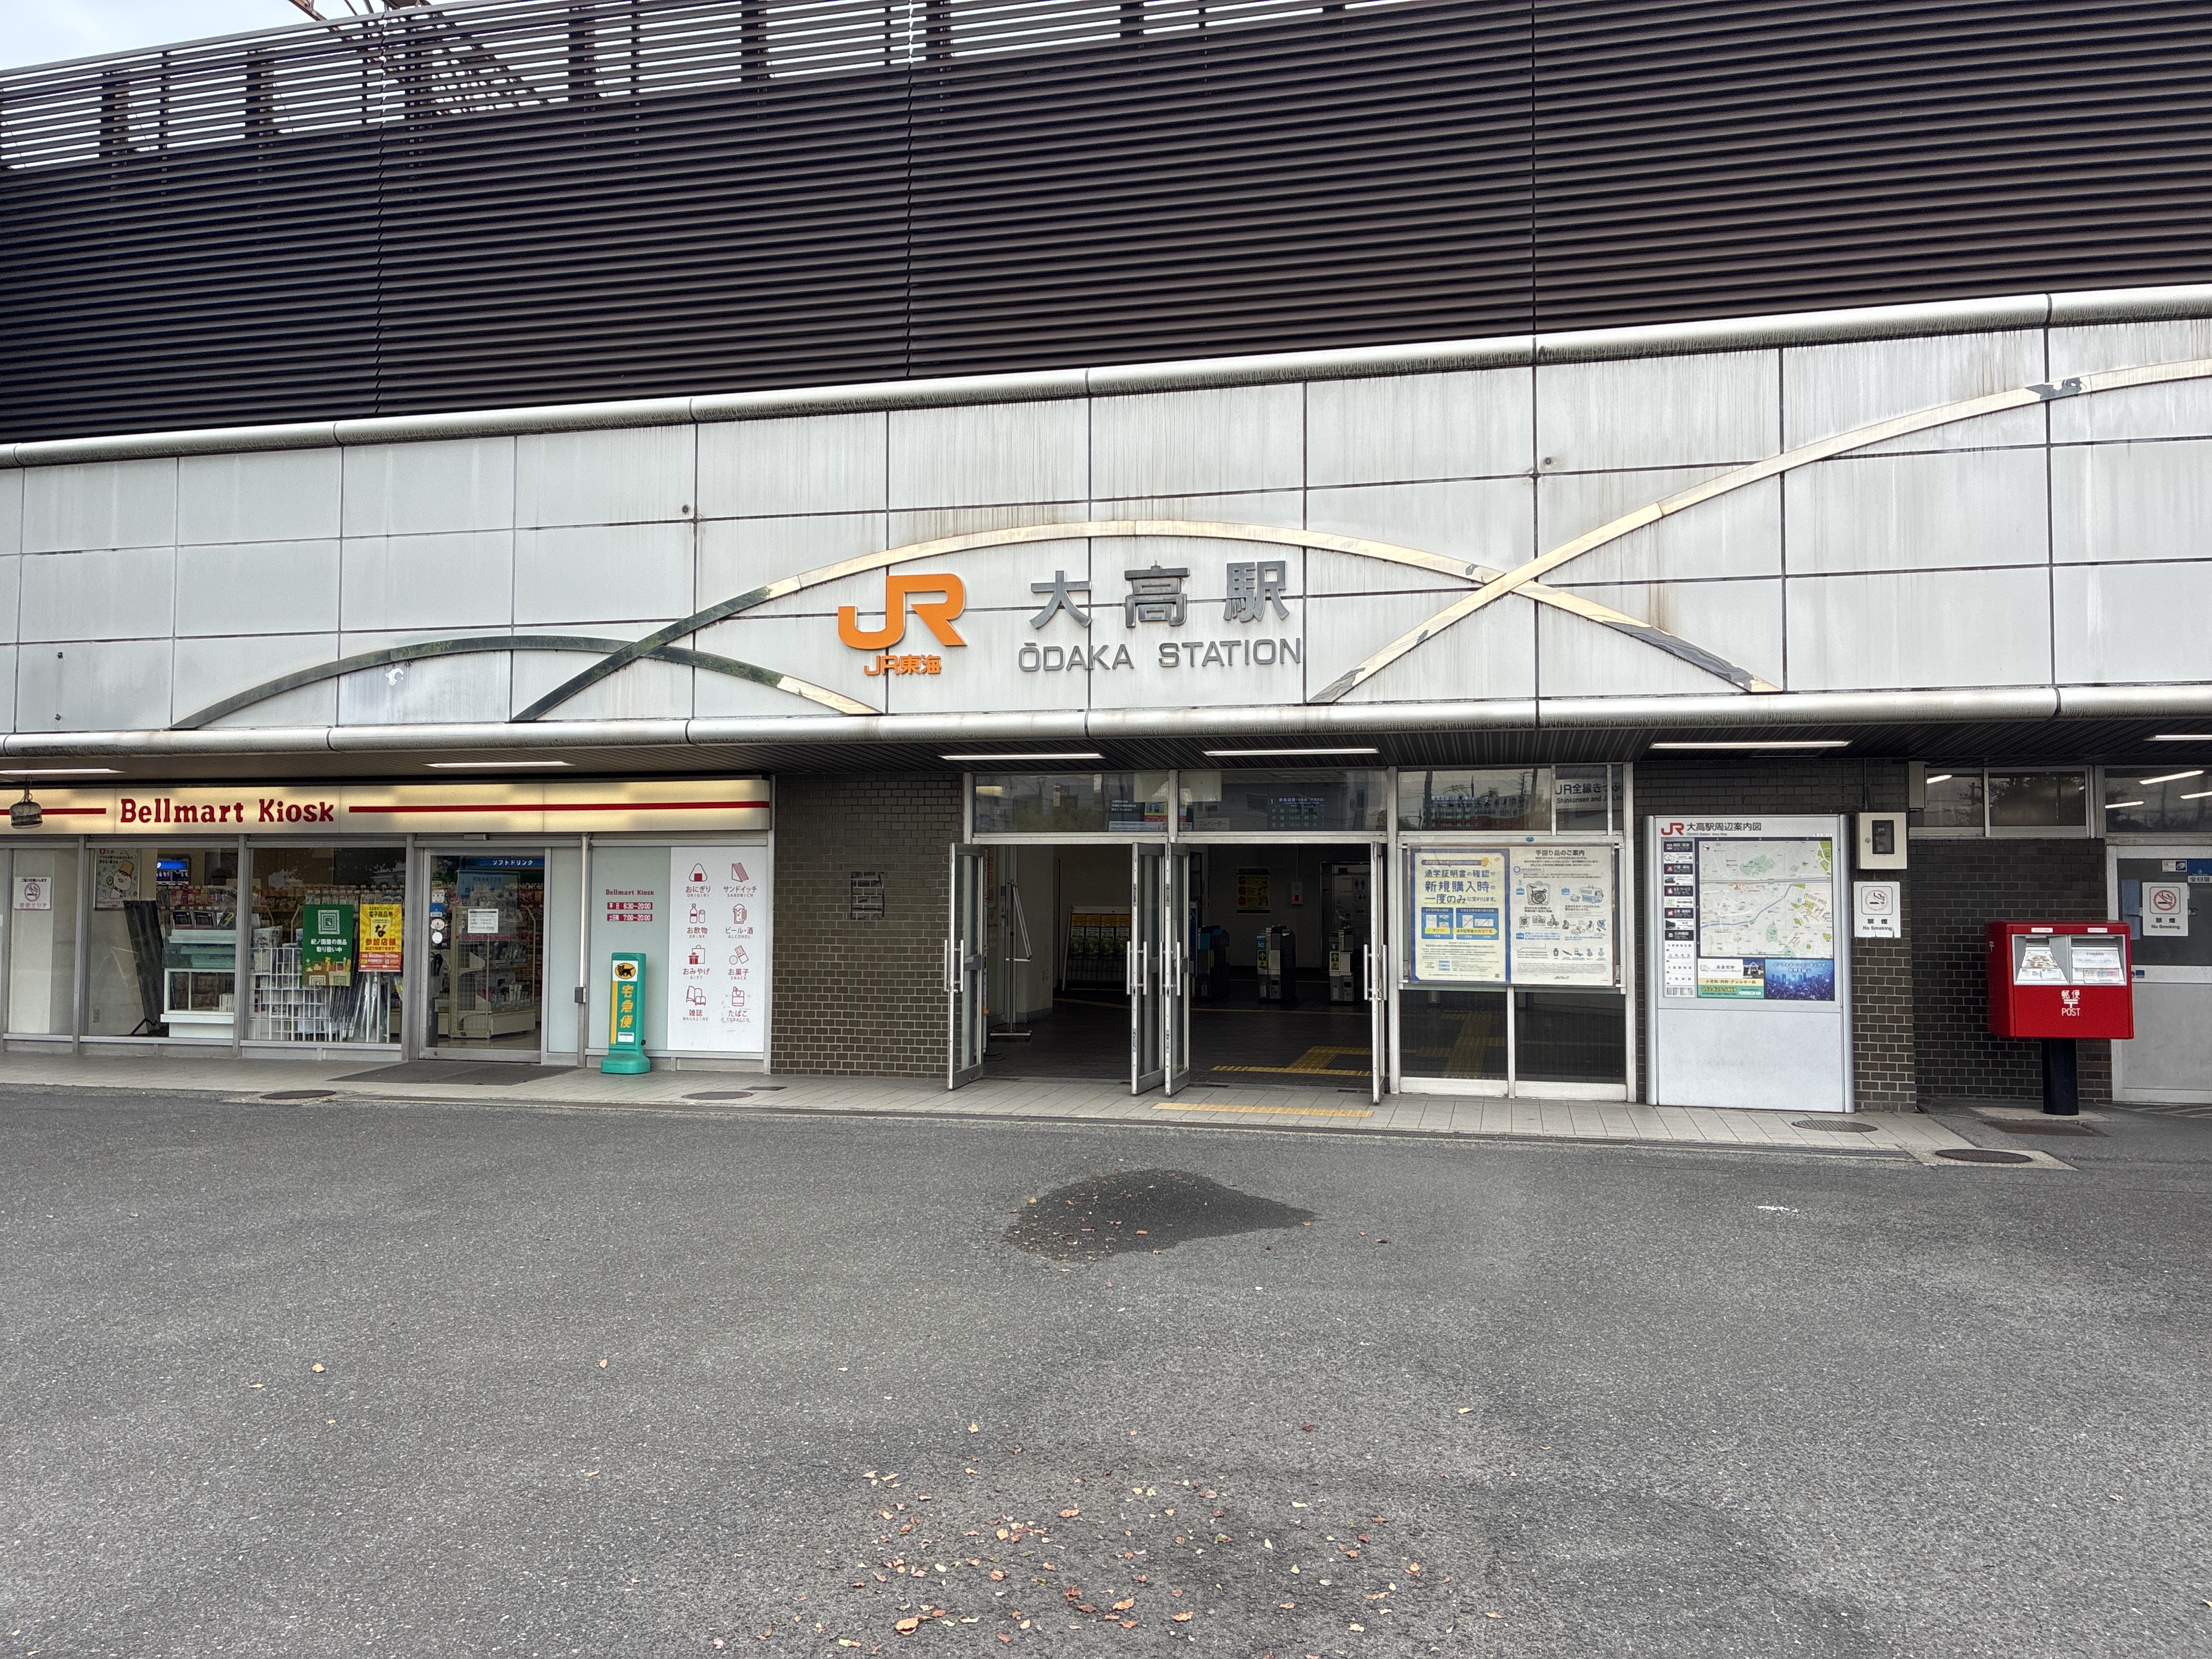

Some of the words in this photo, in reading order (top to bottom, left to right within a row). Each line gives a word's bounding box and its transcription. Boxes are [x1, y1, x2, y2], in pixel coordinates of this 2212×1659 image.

[1029, 560, 1290, 629] 大高駅
[838, 573, 968, 650] JR
[864, 654, 941, 676] JR東海
[1018, 642, 1134, 672] ŌDAKA
[1158, 637, 1301, 669] STATION
[121, 799, 244, 823] Bellmart
[258, 798, 335, 822] Kiosk
[1661, 822, 1685, 836] JR
[1686, 822, 1762, 831] 大高駅周辺案内図
[1425, 881, 1496, 893] 新規購入時の
[2061, 990, 2080, 1000] 郵便
[620, 984, 634, 1029] 宅急便
[2062, 1008, 2080, 1017] POST
